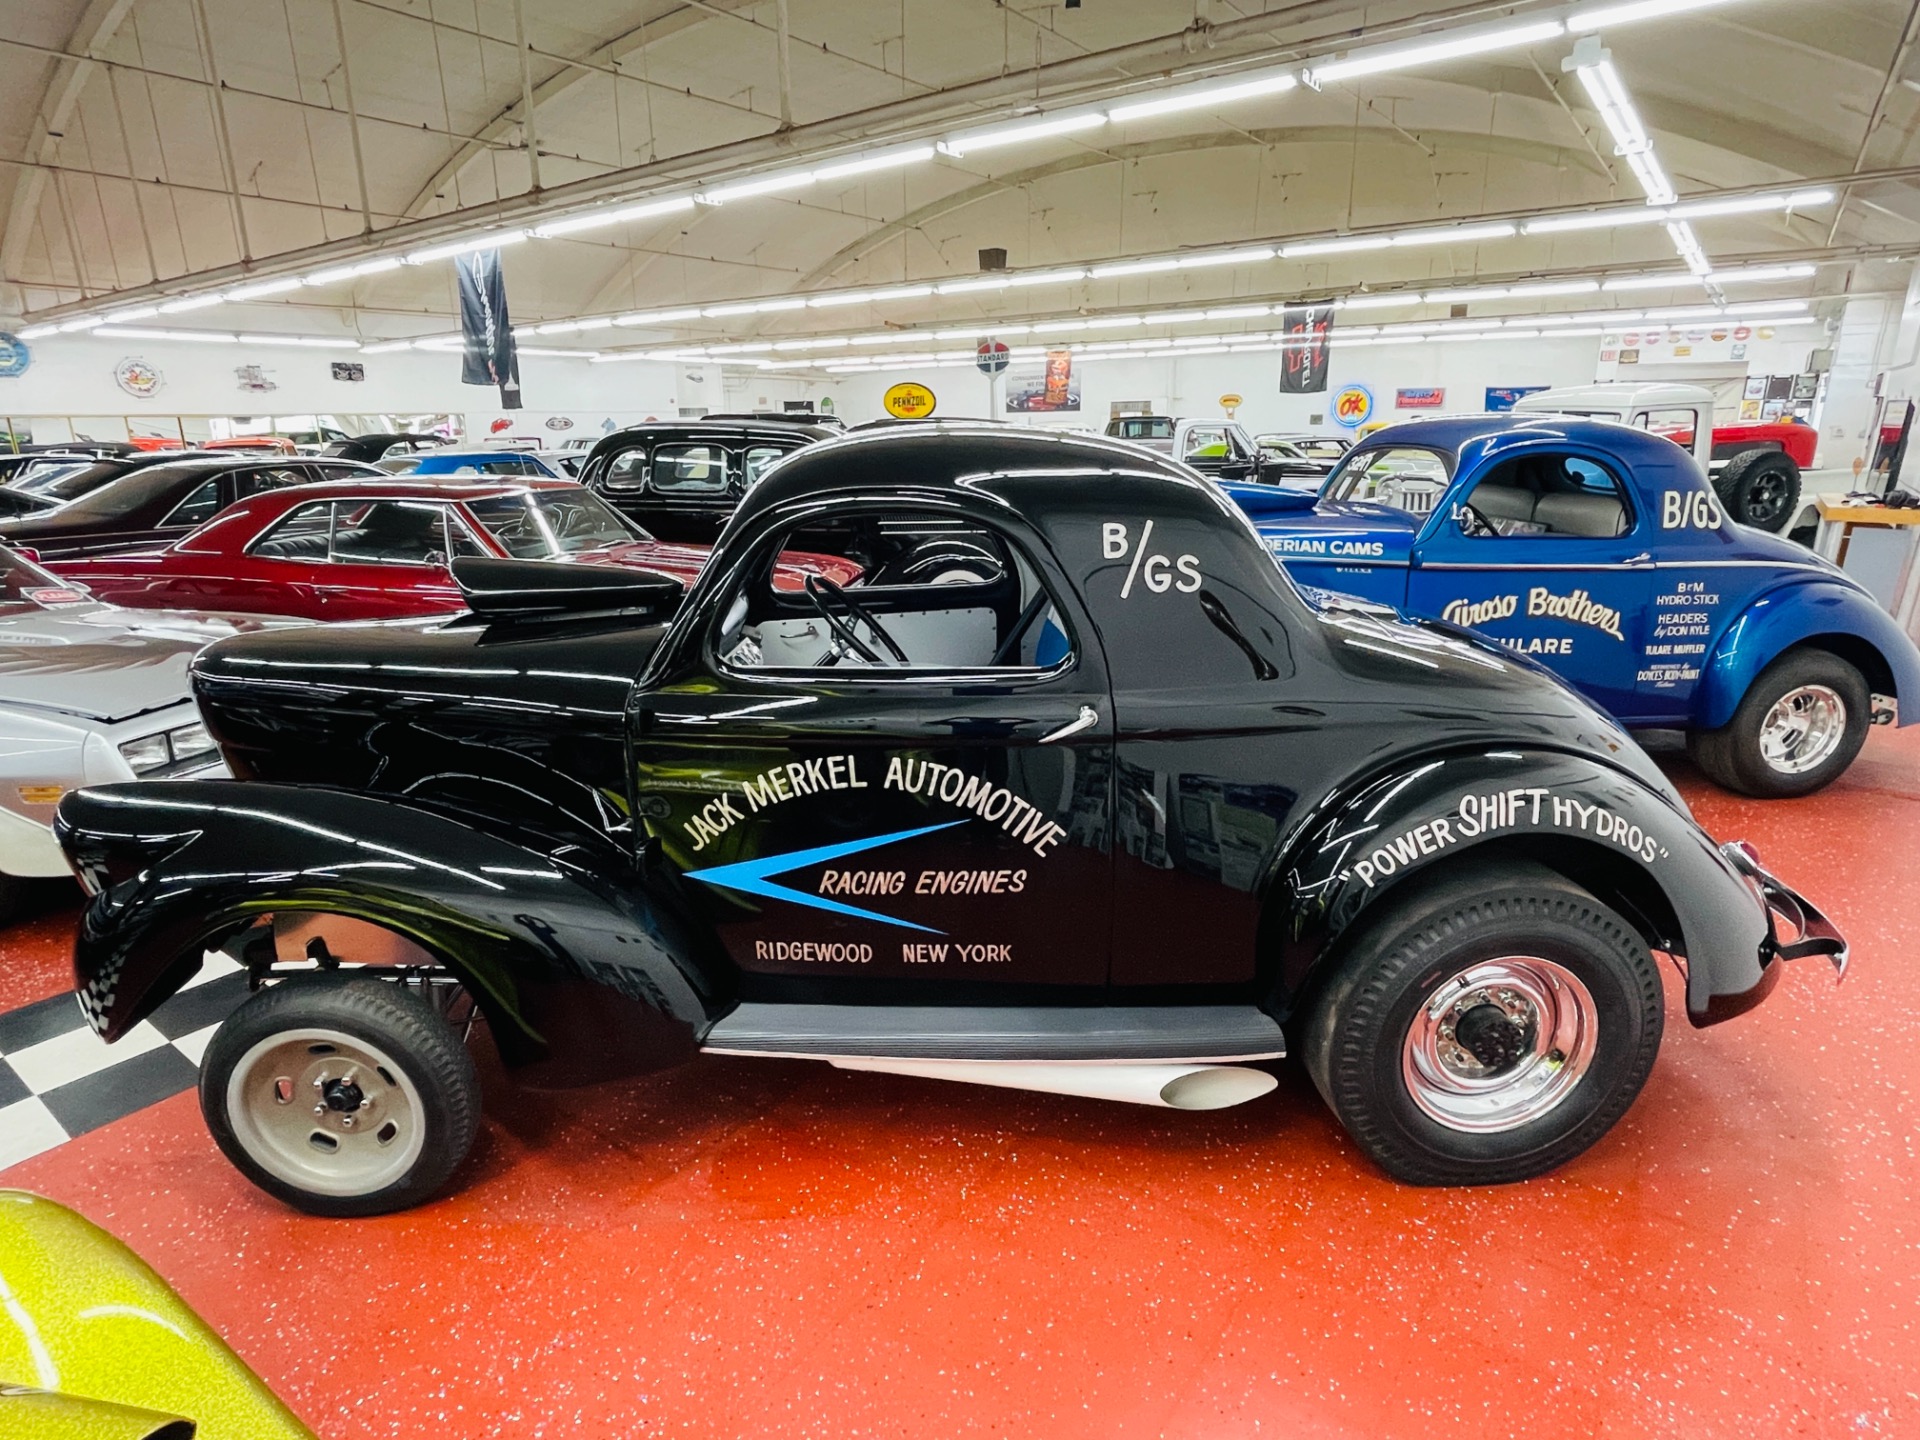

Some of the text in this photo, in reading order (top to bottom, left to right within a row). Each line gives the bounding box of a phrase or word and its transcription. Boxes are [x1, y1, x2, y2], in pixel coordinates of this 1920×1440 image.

[977, 353, 1009, 363] STANDARD
[893, 396, 926, 408] PENNZOIL
[1340, 394, 1363, 416] OK
[1663, 490, 1722, 530] B/GS
[1102, 519, 1202, 599] B/GS
[1330, 541, 1383, 556] CAMS
[1656, 594, 1719, 605] HYDRO STICK
[1528, 587, 1625, 641] Brothers
[1658, 613, 1708, 624] HEADERS
[1653, 625, 1710, 639] by DON KYLE
[1673, 644, 1706, 654] MUFFLER
[683, 755, 1067, 858] JACK MERKEL AUTOMOTIVE
[1456, 788, 1549, 837] SHIFT
[818, 869, 1027, 895] RACING ENGINES
[755, 940, 1012, 963] RIDGEWOOD NEW YORK
